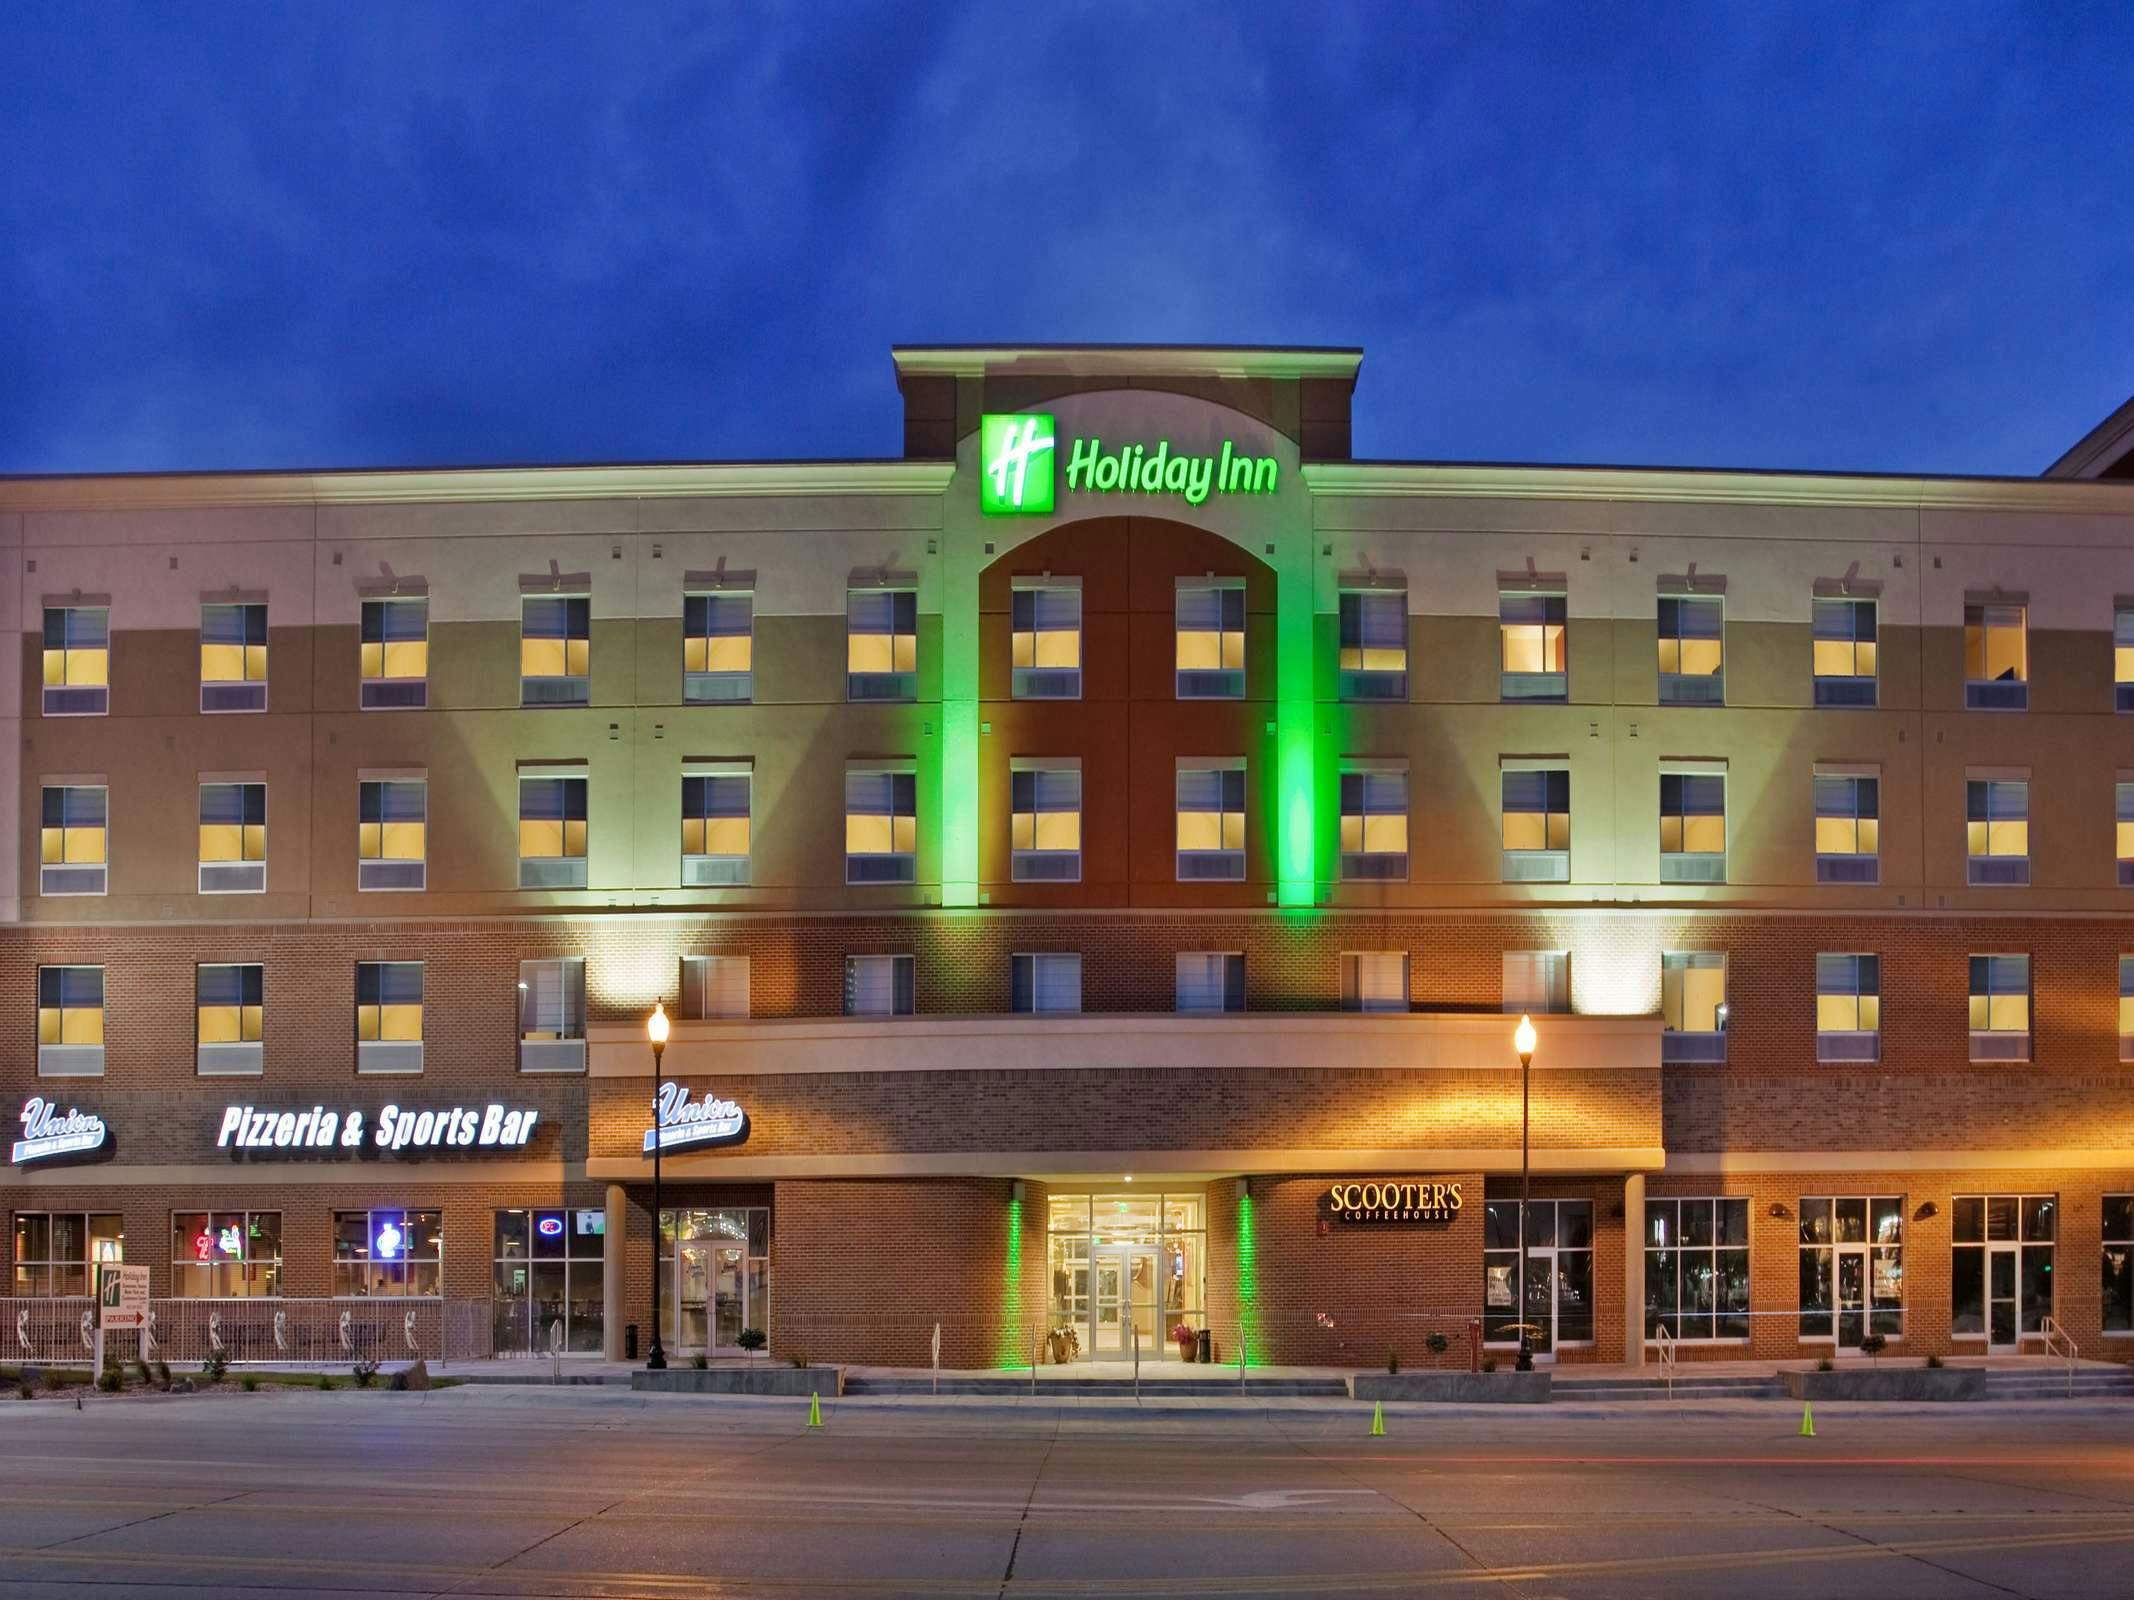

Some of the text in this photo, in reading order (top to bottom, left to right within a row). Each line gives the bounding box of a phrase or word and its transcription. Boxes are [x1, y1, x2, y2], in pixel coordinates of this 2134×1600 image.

[1066, 438, 1278, 504] Holiday Inn
[24, 1097, 99, 1139] Union
[656, 1082, 737, 1127] Union
[217, 1104, 539, 1150] Pizzeria & Sports Bar
[1331, 1183, 1463, 1211] SCOOTER'S
[1344, 1210, 1449, 1220] COFFEEHOUSE
